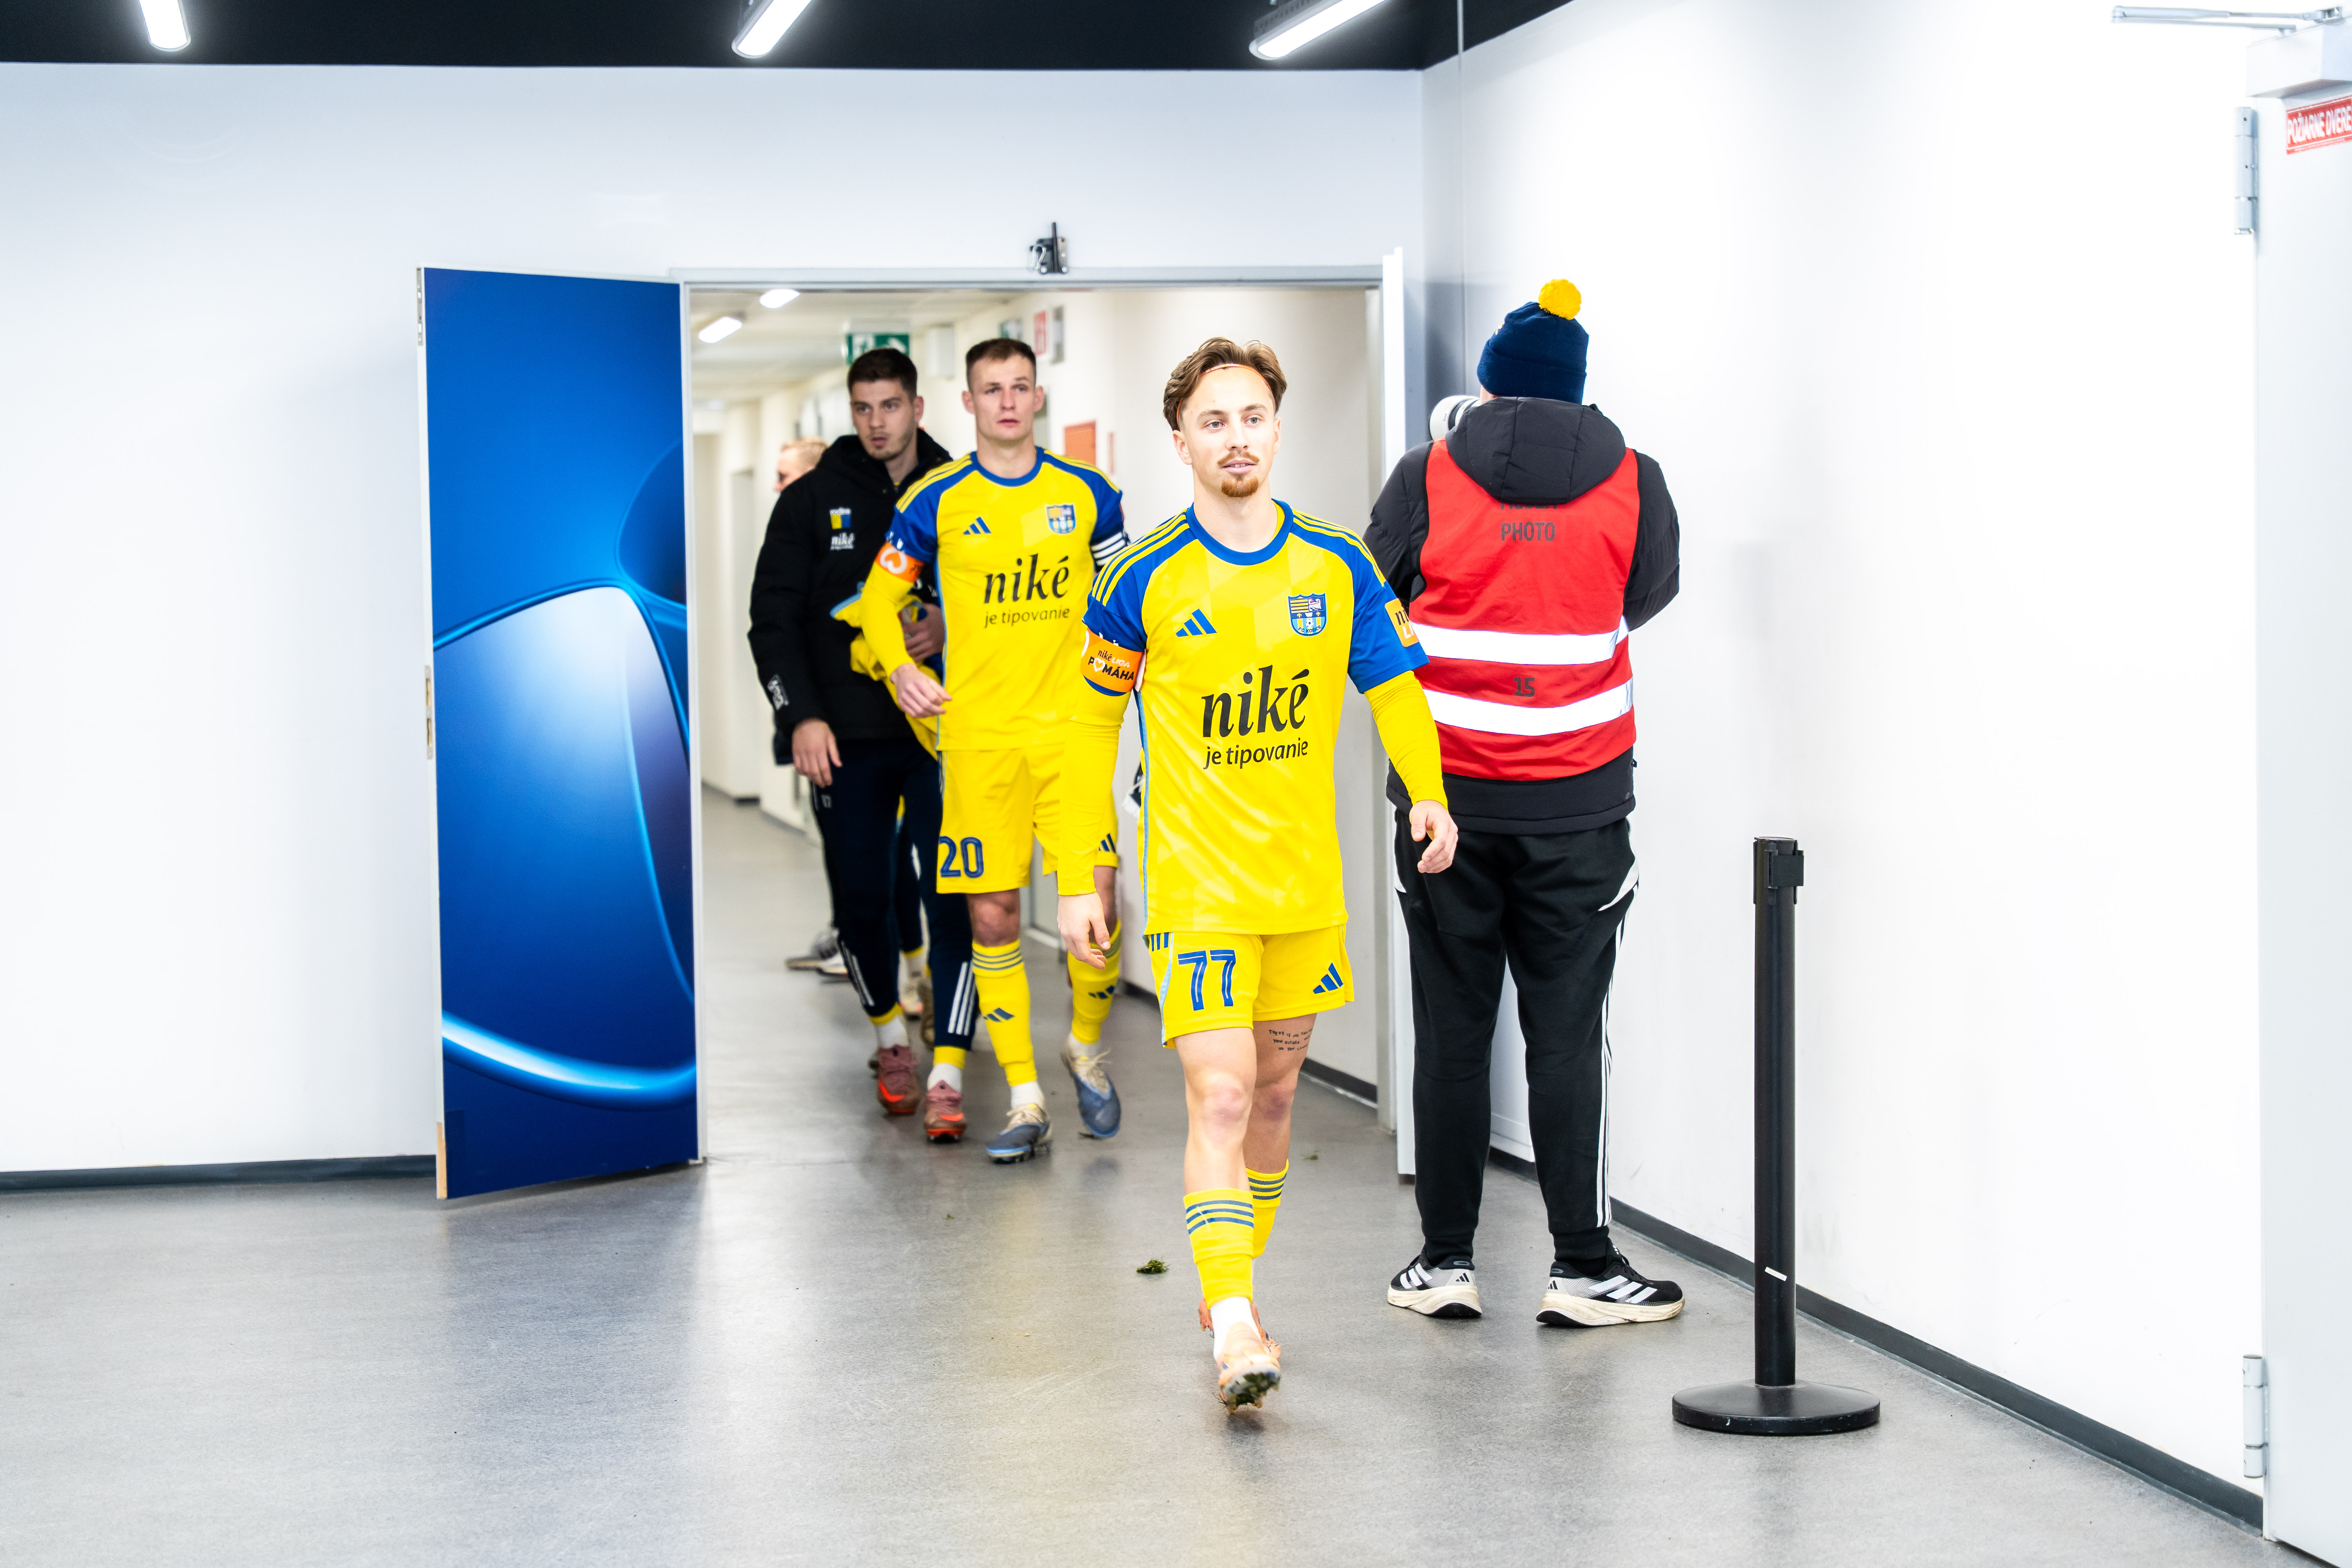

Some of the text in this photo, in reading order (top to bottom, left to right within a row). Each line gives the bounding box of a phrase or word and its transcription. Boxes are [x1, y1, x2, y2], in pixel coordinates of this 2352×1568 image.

[2326, 105, 2351, 136] DVERE
[1501, 522, 1555, 541] PHOTO
[984, 553, 1069, 604] niké
[984, 605, 1070, 628] je tipovanie
[1111, 657, 1130, 668] LIGA
[1201, 665, 1309, 737] niké
[1514, 677, 1535, 697] 15
[1203, 737, 1308, 769] je tipovanie
[939, 835, 984, 878] 20
[1178, 949, 1236, 1011] 77
